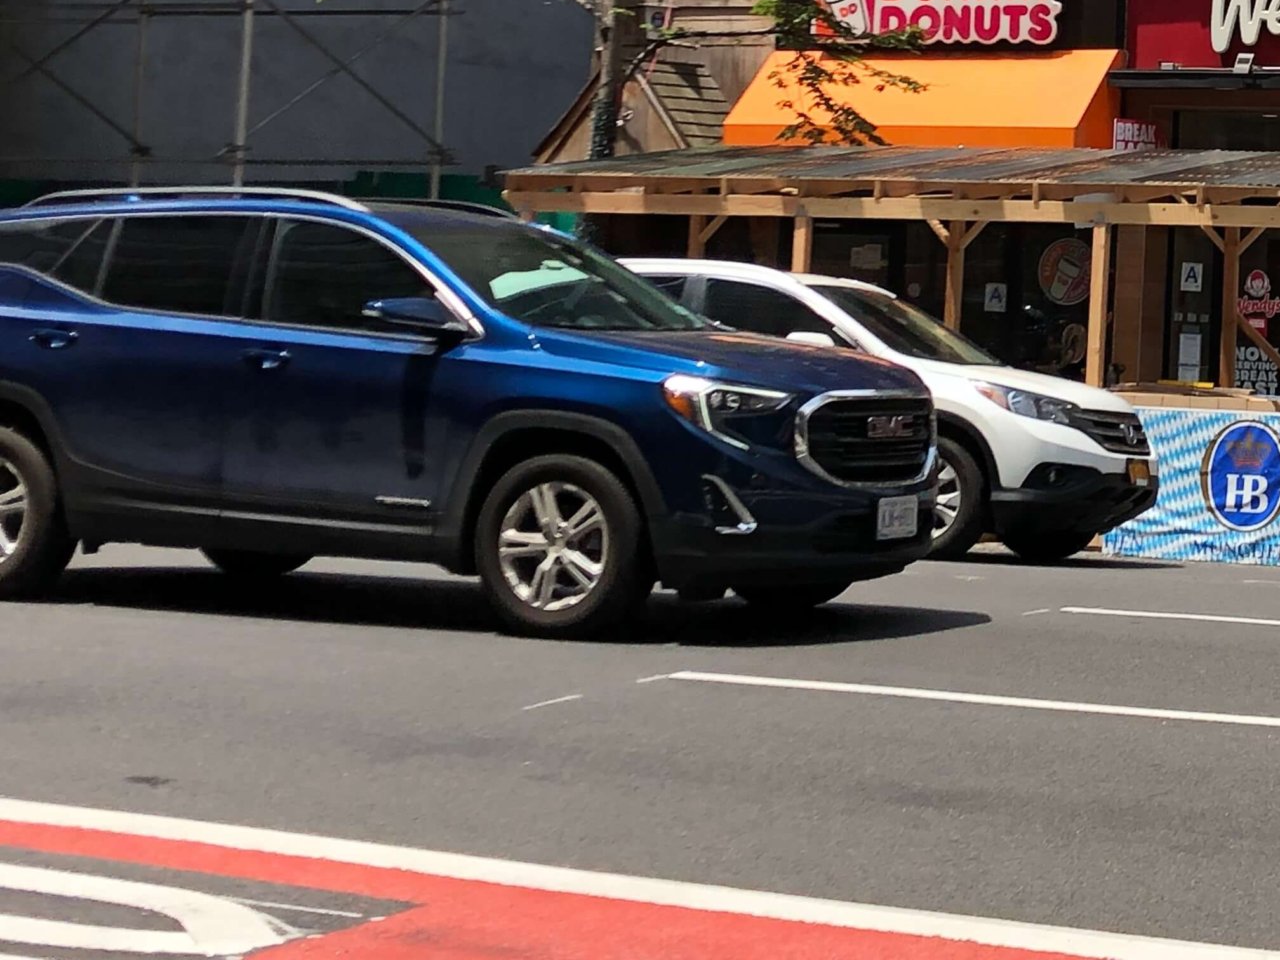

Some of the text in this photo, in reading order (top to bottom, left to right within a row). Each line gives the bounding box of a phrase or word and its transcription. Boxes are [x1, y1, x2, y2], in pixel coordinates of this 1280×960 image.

[880, 3, 1053, 41] DONUTS
[1116, 122, 1156, 142] BREAK
[1184, 266, 1199, 283] A
[989, 287, 1003, 302] A
[1224, 473, 1269, 514] HB
